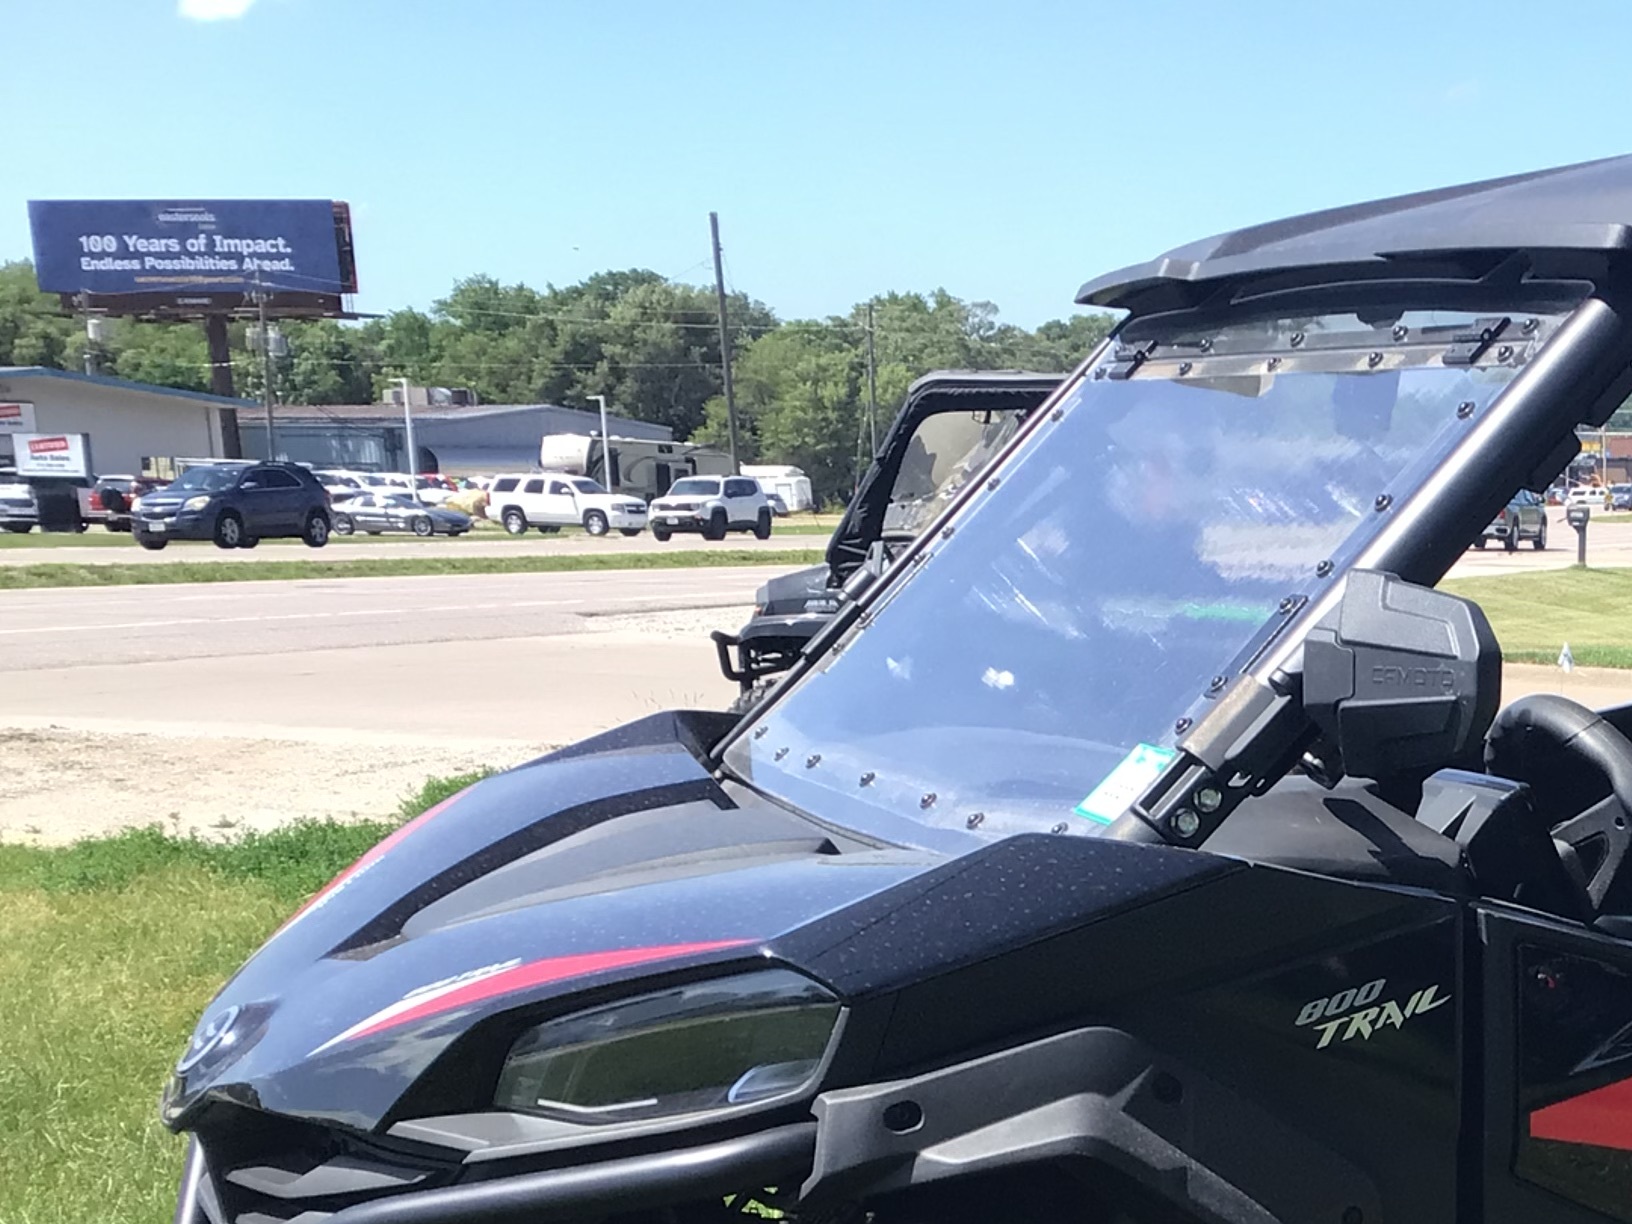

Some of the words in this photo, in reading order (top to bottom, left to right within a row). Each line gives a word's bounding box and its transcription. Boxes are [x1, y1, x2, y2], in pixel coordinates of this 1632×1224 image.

[78, 235, 118, 252] 100
[122, 235, 181, 252] Years
[185, 233, 208, 252] of
[212, 235, 293, 255] Impact.
[80, 257, 142, 271] Endless
[144, 255, 238, 271] Possibilities
[242, 257, 296, 271] Ahead.
[1370, 664, 1457, 689] CFMOTO
[1295, 978, 1387, 1026] 800
[1313, 984, 1452, 1050] TRAIL
